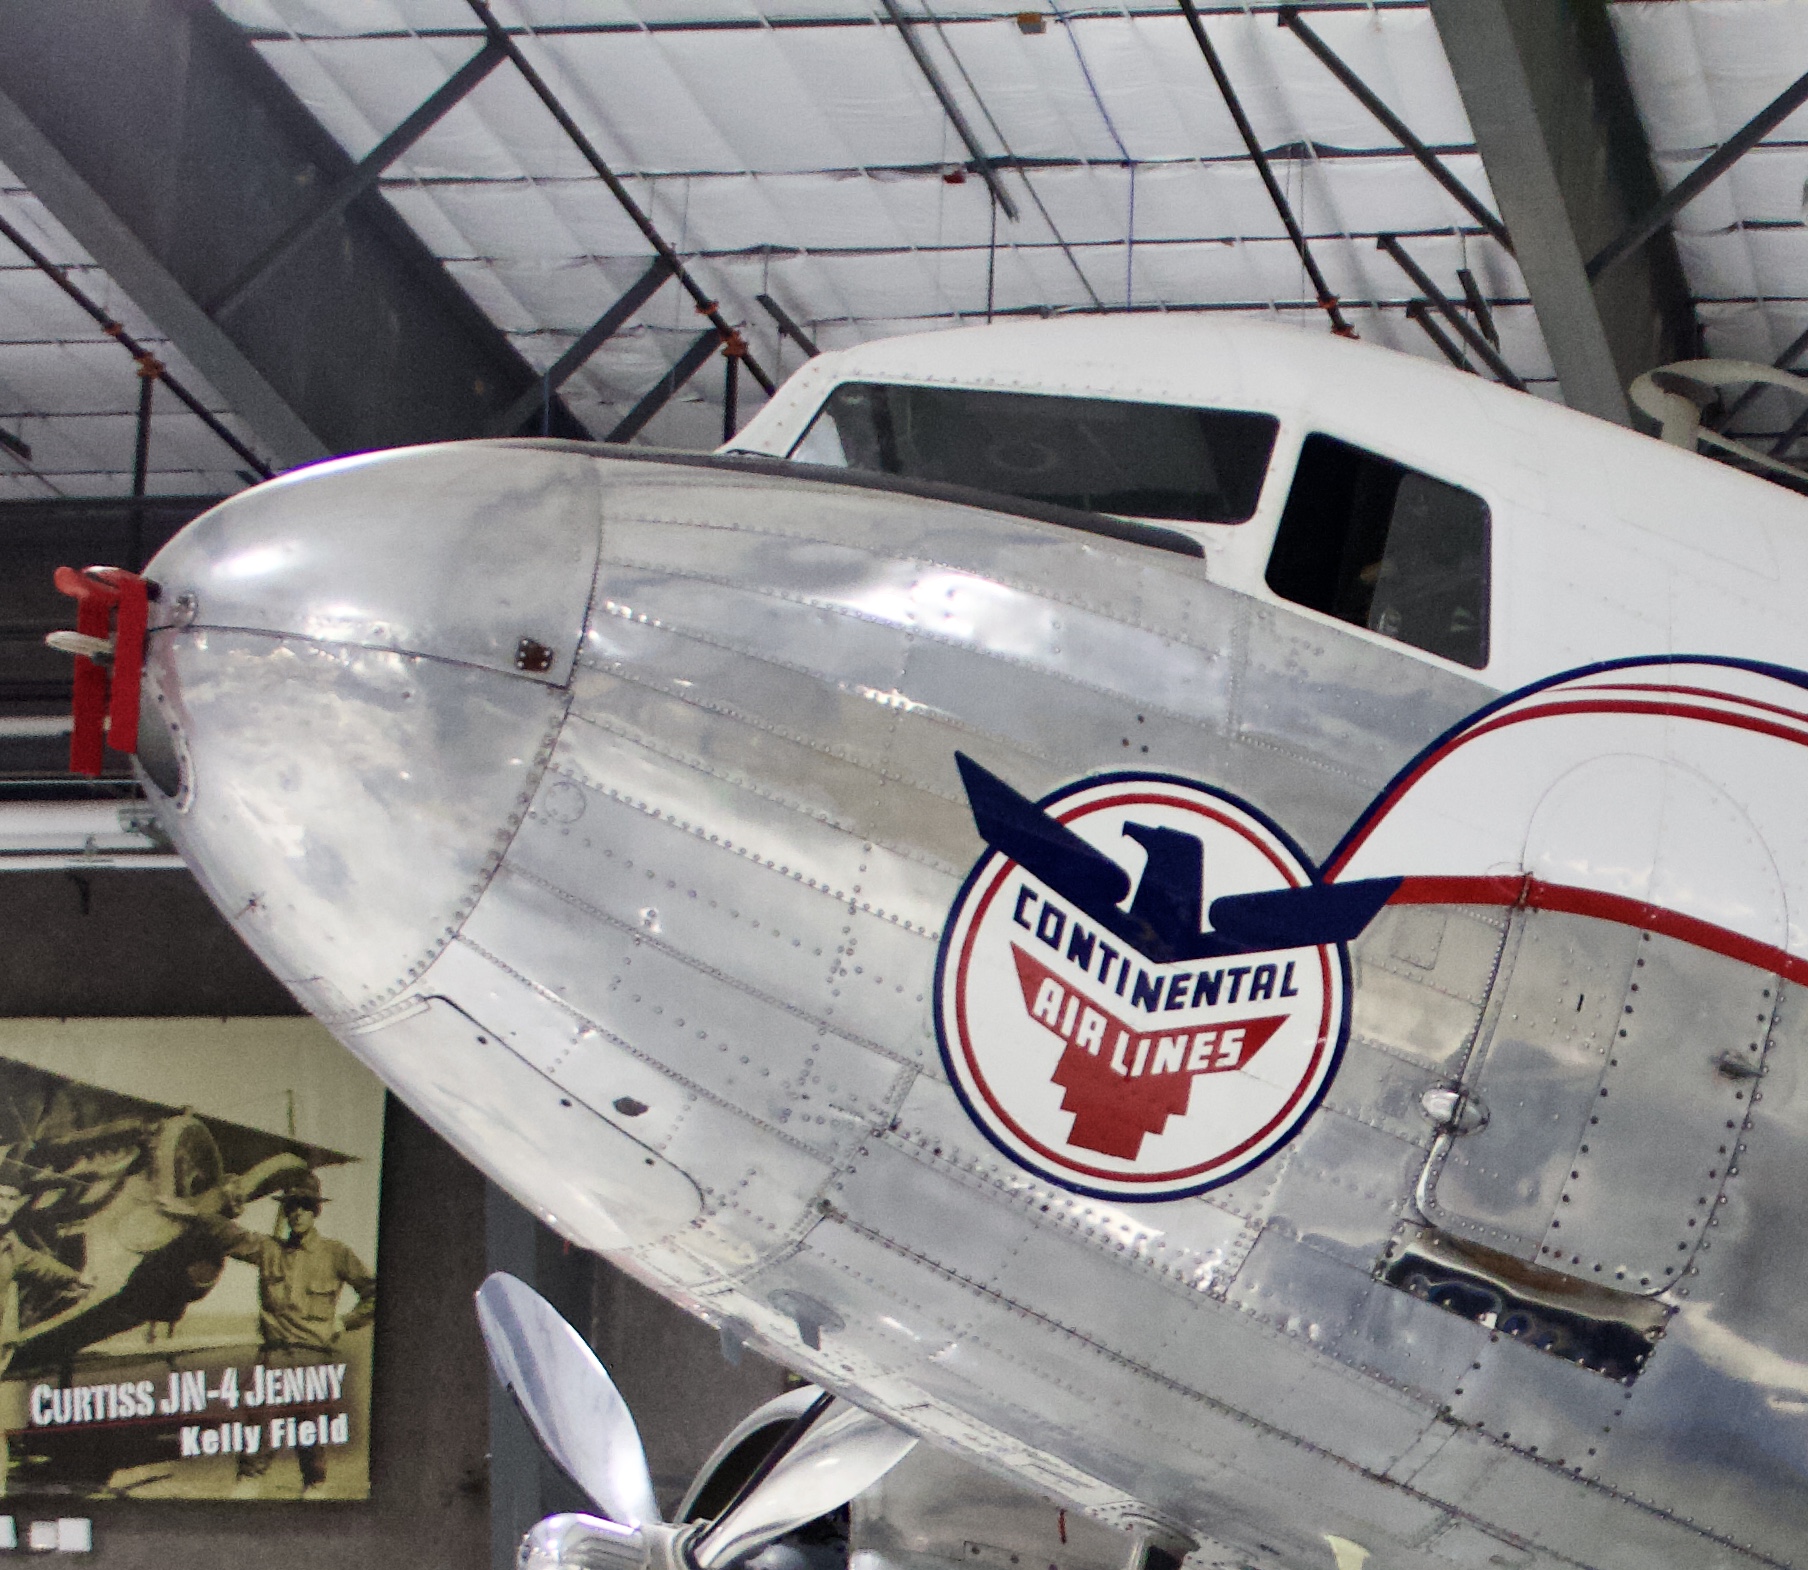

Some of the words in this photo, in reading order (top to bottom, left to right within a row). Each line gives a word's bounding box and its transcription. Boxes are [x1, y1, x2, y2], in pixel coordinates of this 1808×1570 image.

[1012, 882, 1299, 1014] CONTINENTAL
[30, 1380, 156, 1427] CURTISS
[159, 1366, 240, 1416] JN-4
[244, 1363, 347, 1407] JENNY
[180, 1421, 262, 1458] Kelly
[269, 1412, 350, 1449] Field
